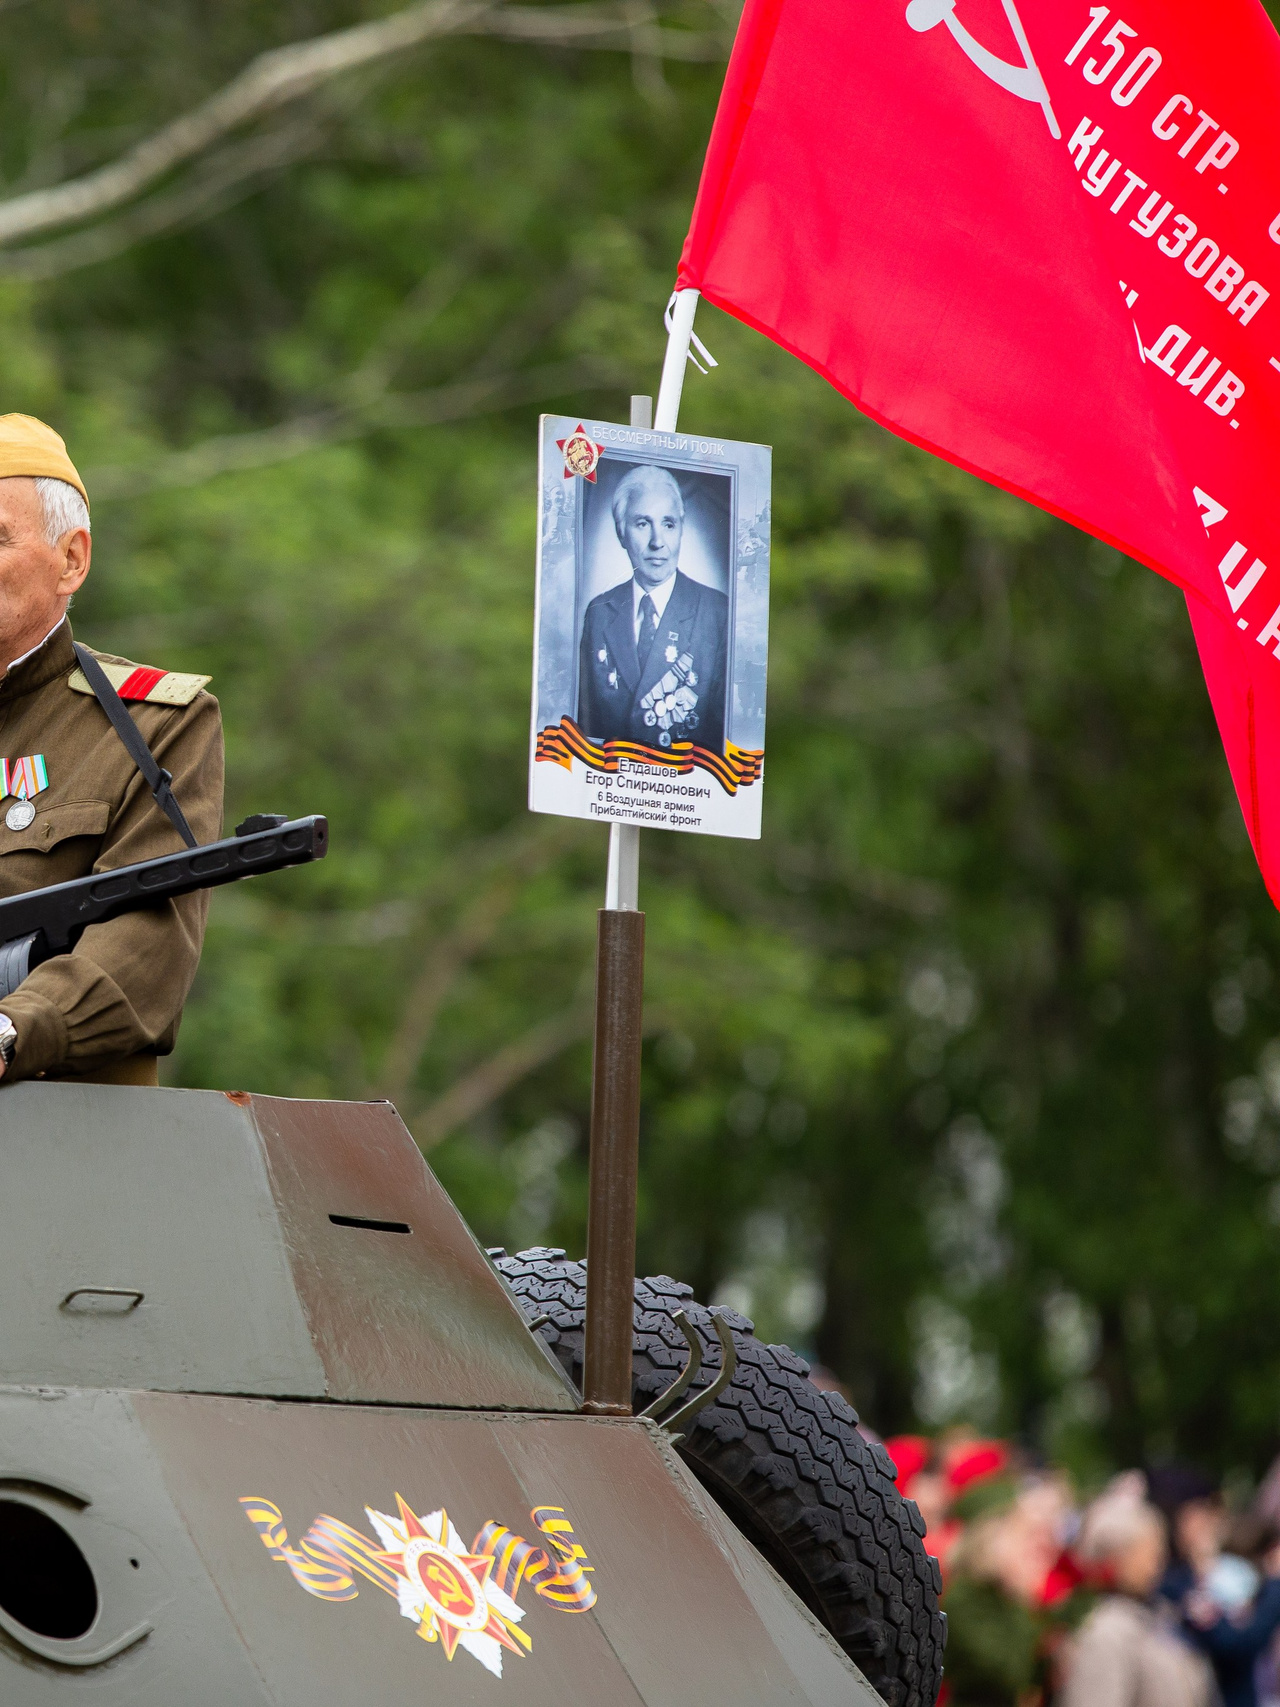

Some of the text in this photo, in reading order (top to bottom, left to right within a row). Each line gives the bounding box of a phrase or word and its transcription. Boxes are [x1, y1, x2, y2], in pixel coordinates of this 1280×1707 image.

[1064, 6, 1240, 195] 150 СТР.
[1067, 116, 1271, 327] КУТУЗОВА
[1143, 324, 1246, 430] ДИВ.
[592, 426, 725, 456] БЕССМЕРТНЫЙ ПОЛК
[619, 759, 677, 778] Елдашов
[585, 771, 711, 798] Егор Спиридонович
[590, 803, 702, 826] Прибалтийский фронт
[597, 791, 695, 813] 6 Воздушная армия
